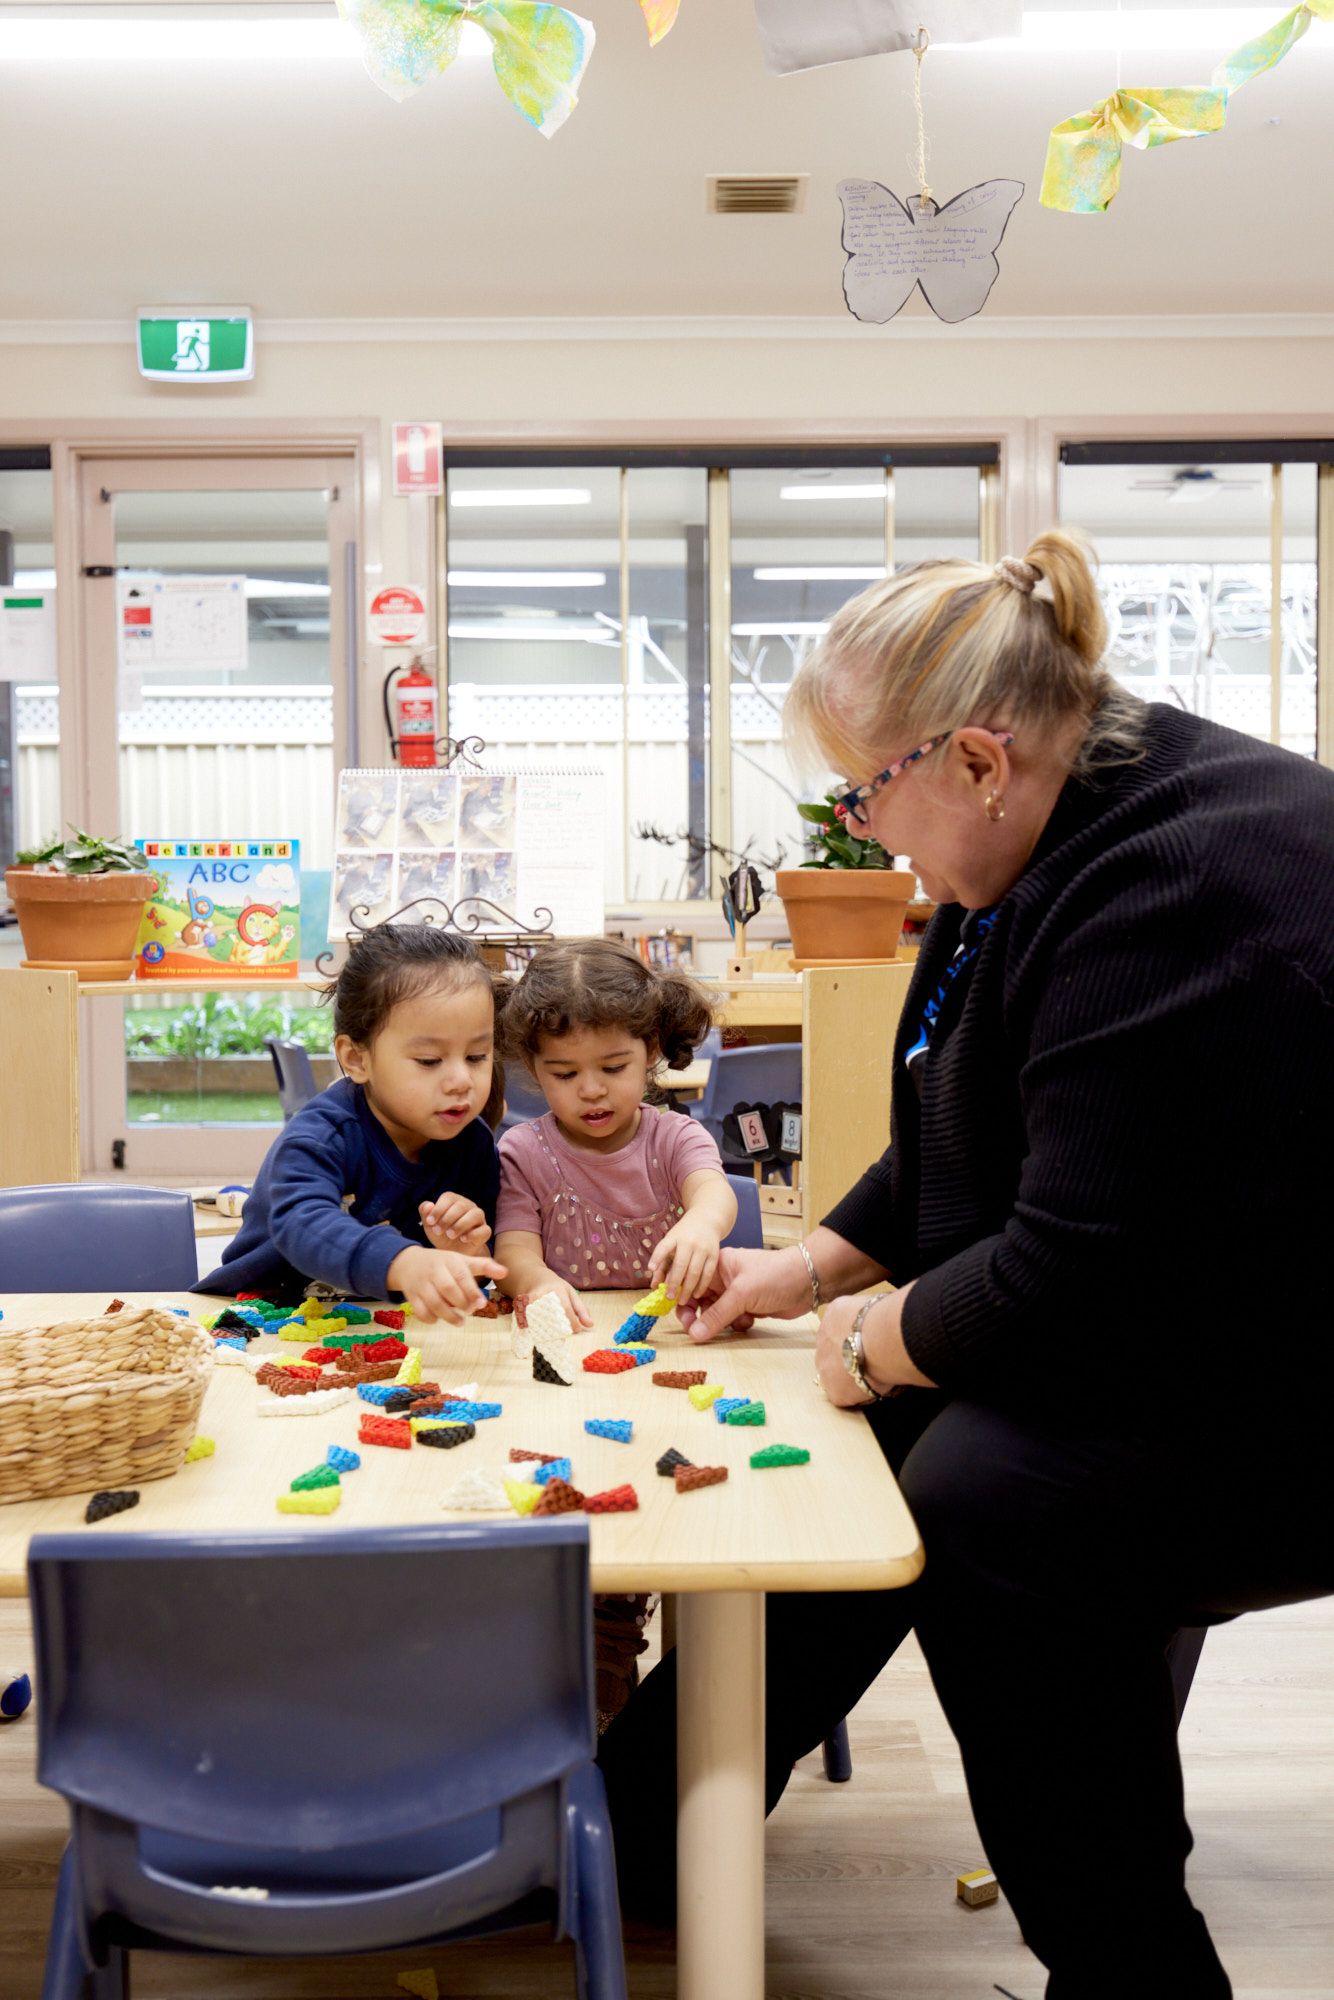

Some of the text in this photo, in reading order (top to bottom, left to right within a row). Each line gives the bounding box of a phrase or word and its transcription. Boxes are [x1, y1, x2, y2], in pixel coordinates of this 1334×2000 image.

[147, 843, 288, 857] Letterland
[188, 862, 250, 884] ABC
[177, 967, 200, 975] parents
[749, 1120, 757, 1136] 6
[788, 1120, 795, 1136] 8
